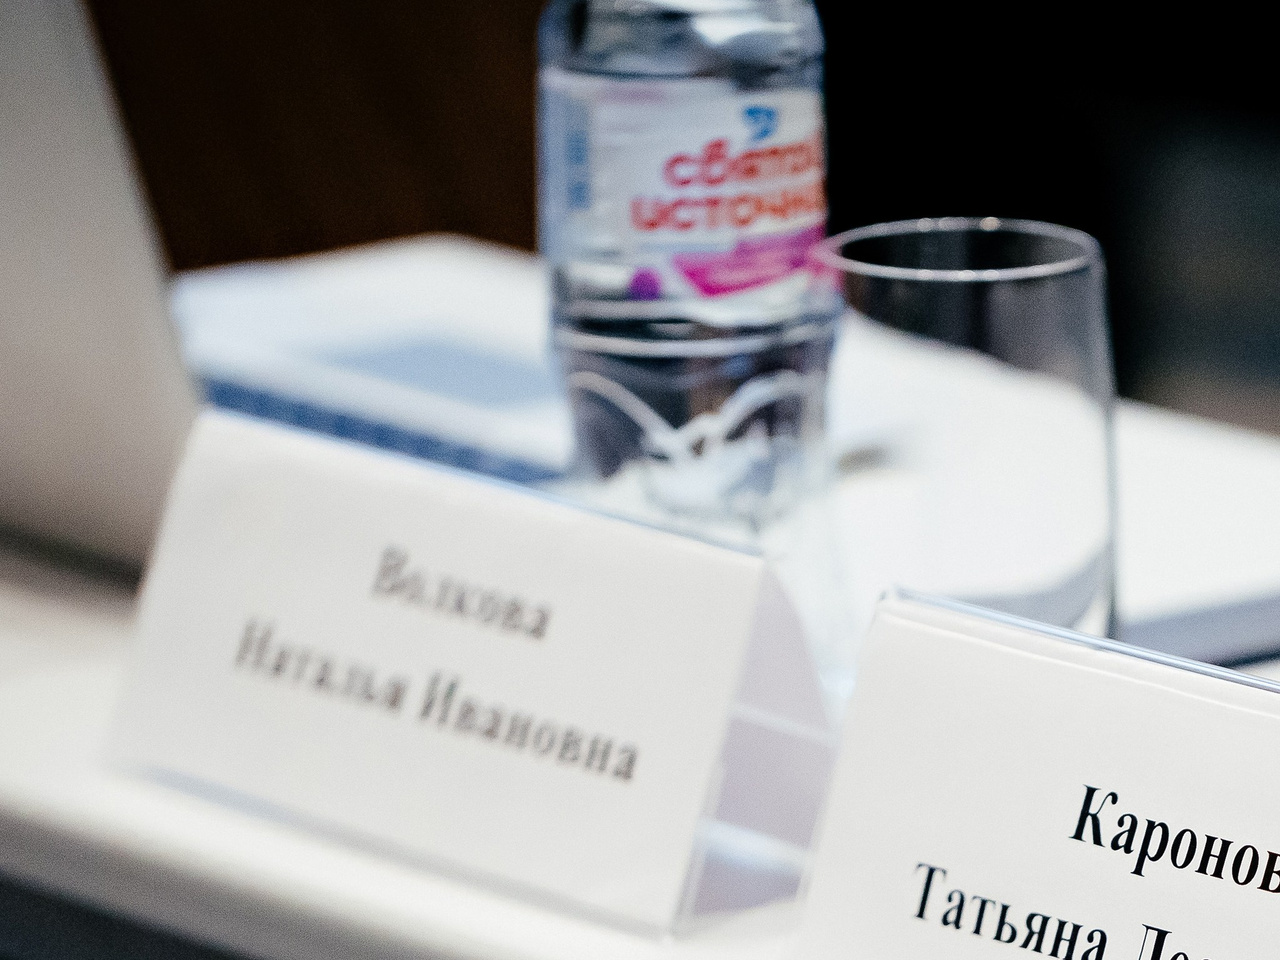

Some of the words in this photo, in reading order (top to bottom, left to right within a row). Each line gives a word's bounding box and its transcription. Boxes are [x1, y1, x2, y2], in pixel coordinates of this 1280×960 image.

[374, 547, 551, 641] Волкова
[235, 620, 409, 715] Наталья
[418, 671, 639, 782] Ивановна
